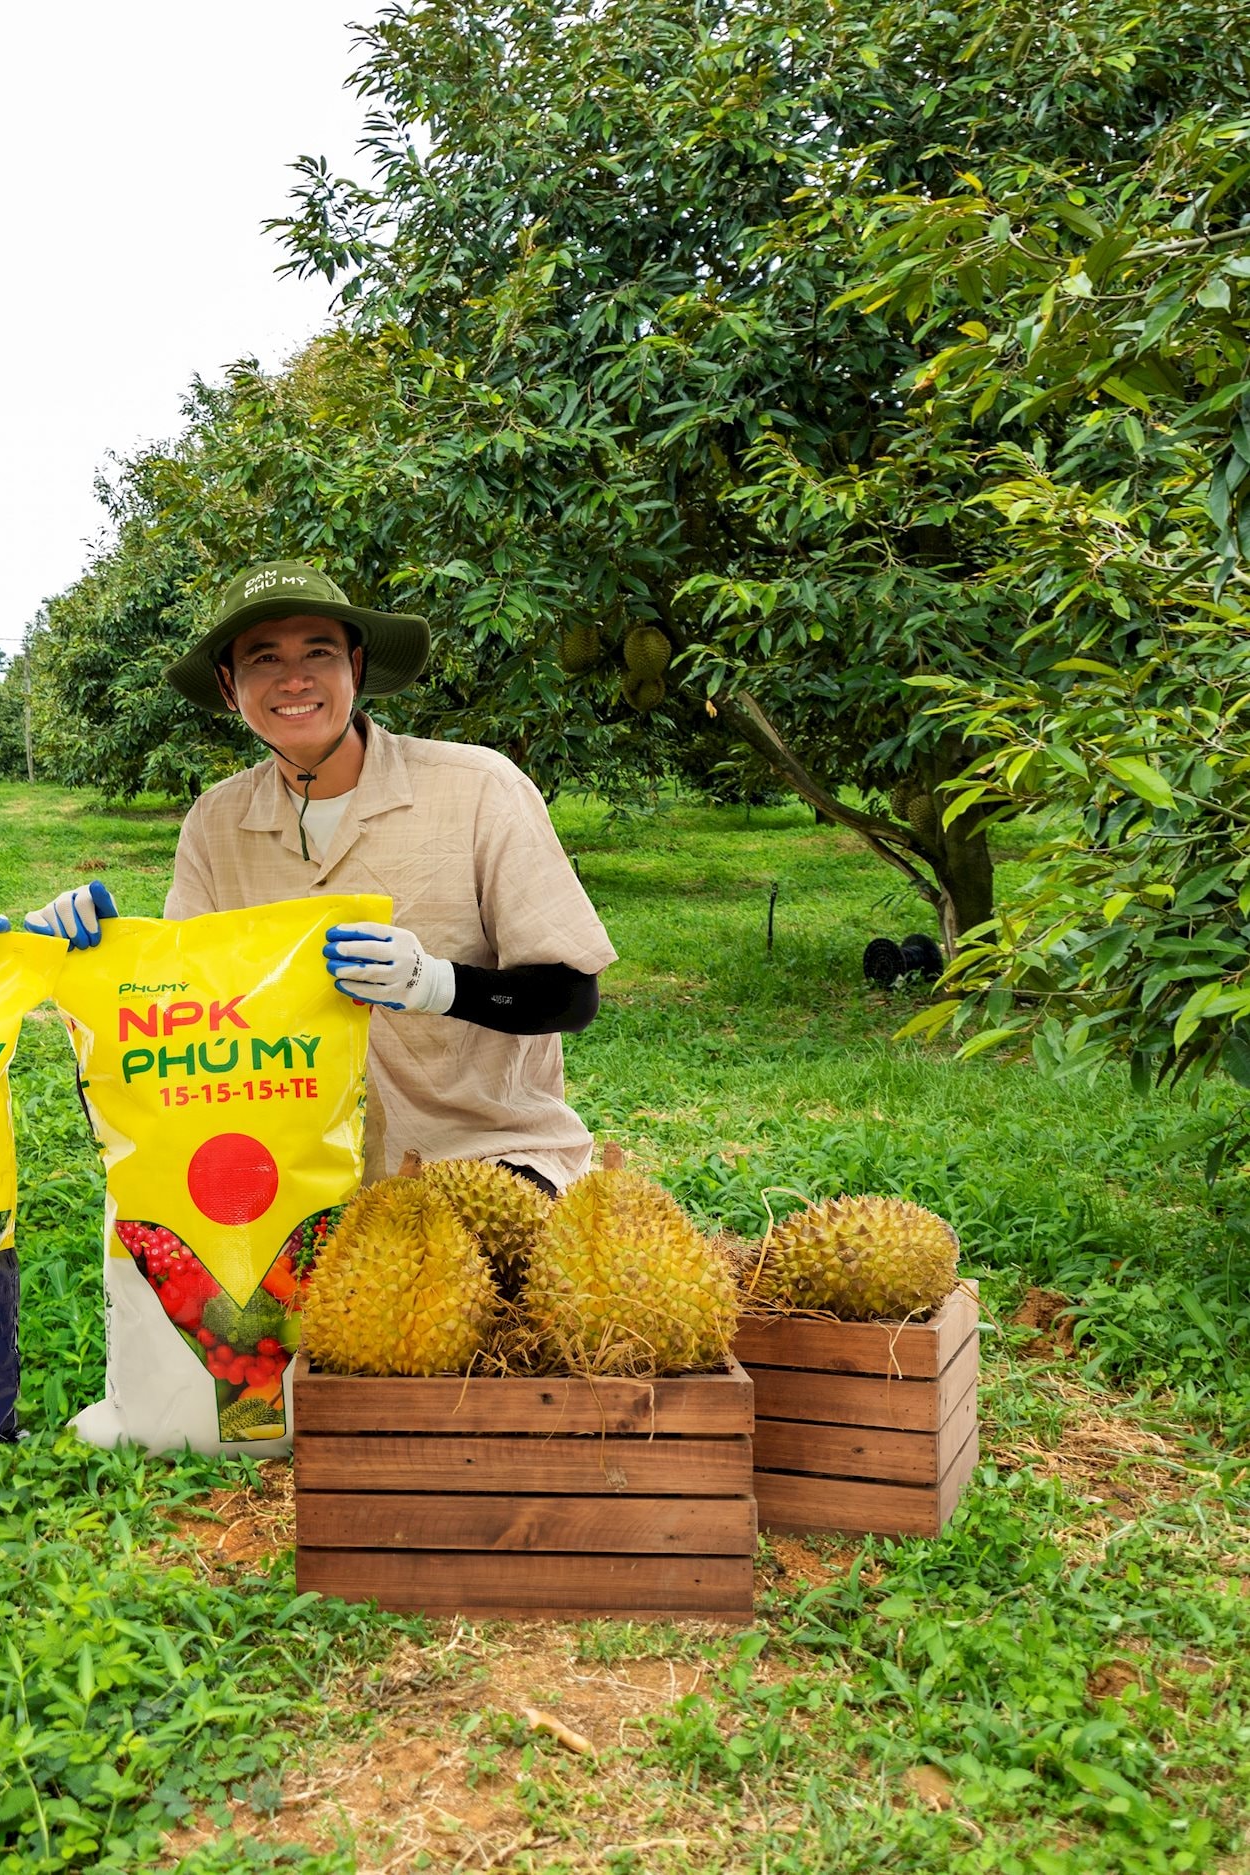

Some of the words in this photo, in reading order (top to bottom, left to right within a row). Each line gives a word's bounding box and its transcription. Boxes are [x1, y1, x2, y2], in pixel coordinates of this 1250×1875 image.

[243, 575, 277, 599] PHÚ
[118, 994, 251, 1042] NPK
[122, 1037, 239, 1083] PHÚ
[251, 1033, 322, 1071] MỸ
[159, 1077, 319, 1107] 15-15-15+TE
